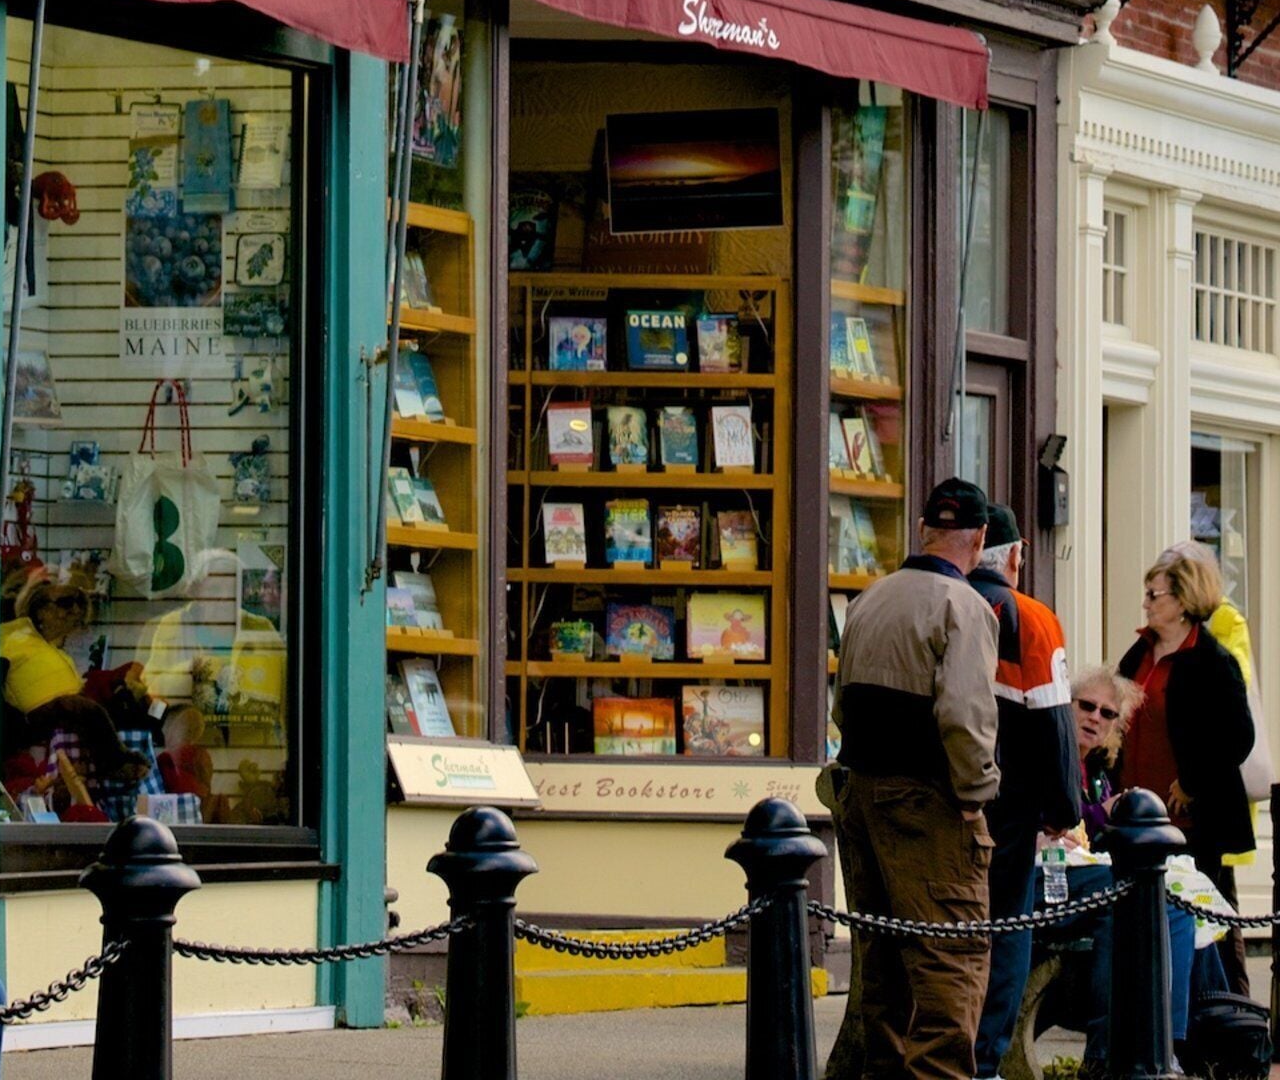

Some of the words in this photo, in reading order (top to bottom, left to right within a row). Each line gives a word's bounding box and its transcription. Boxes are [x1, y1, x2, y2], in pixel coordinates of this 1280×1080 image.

[124, 319, 221, 331] BLUEBERRIES
[629, 314, 685, 329] OCEAN
[125, 337, 221, 355] MAINE
[535, 779, 581, 798] dest
[596, 777, 715, 800] Bookstore
[766, 780, 800, 792] Since
